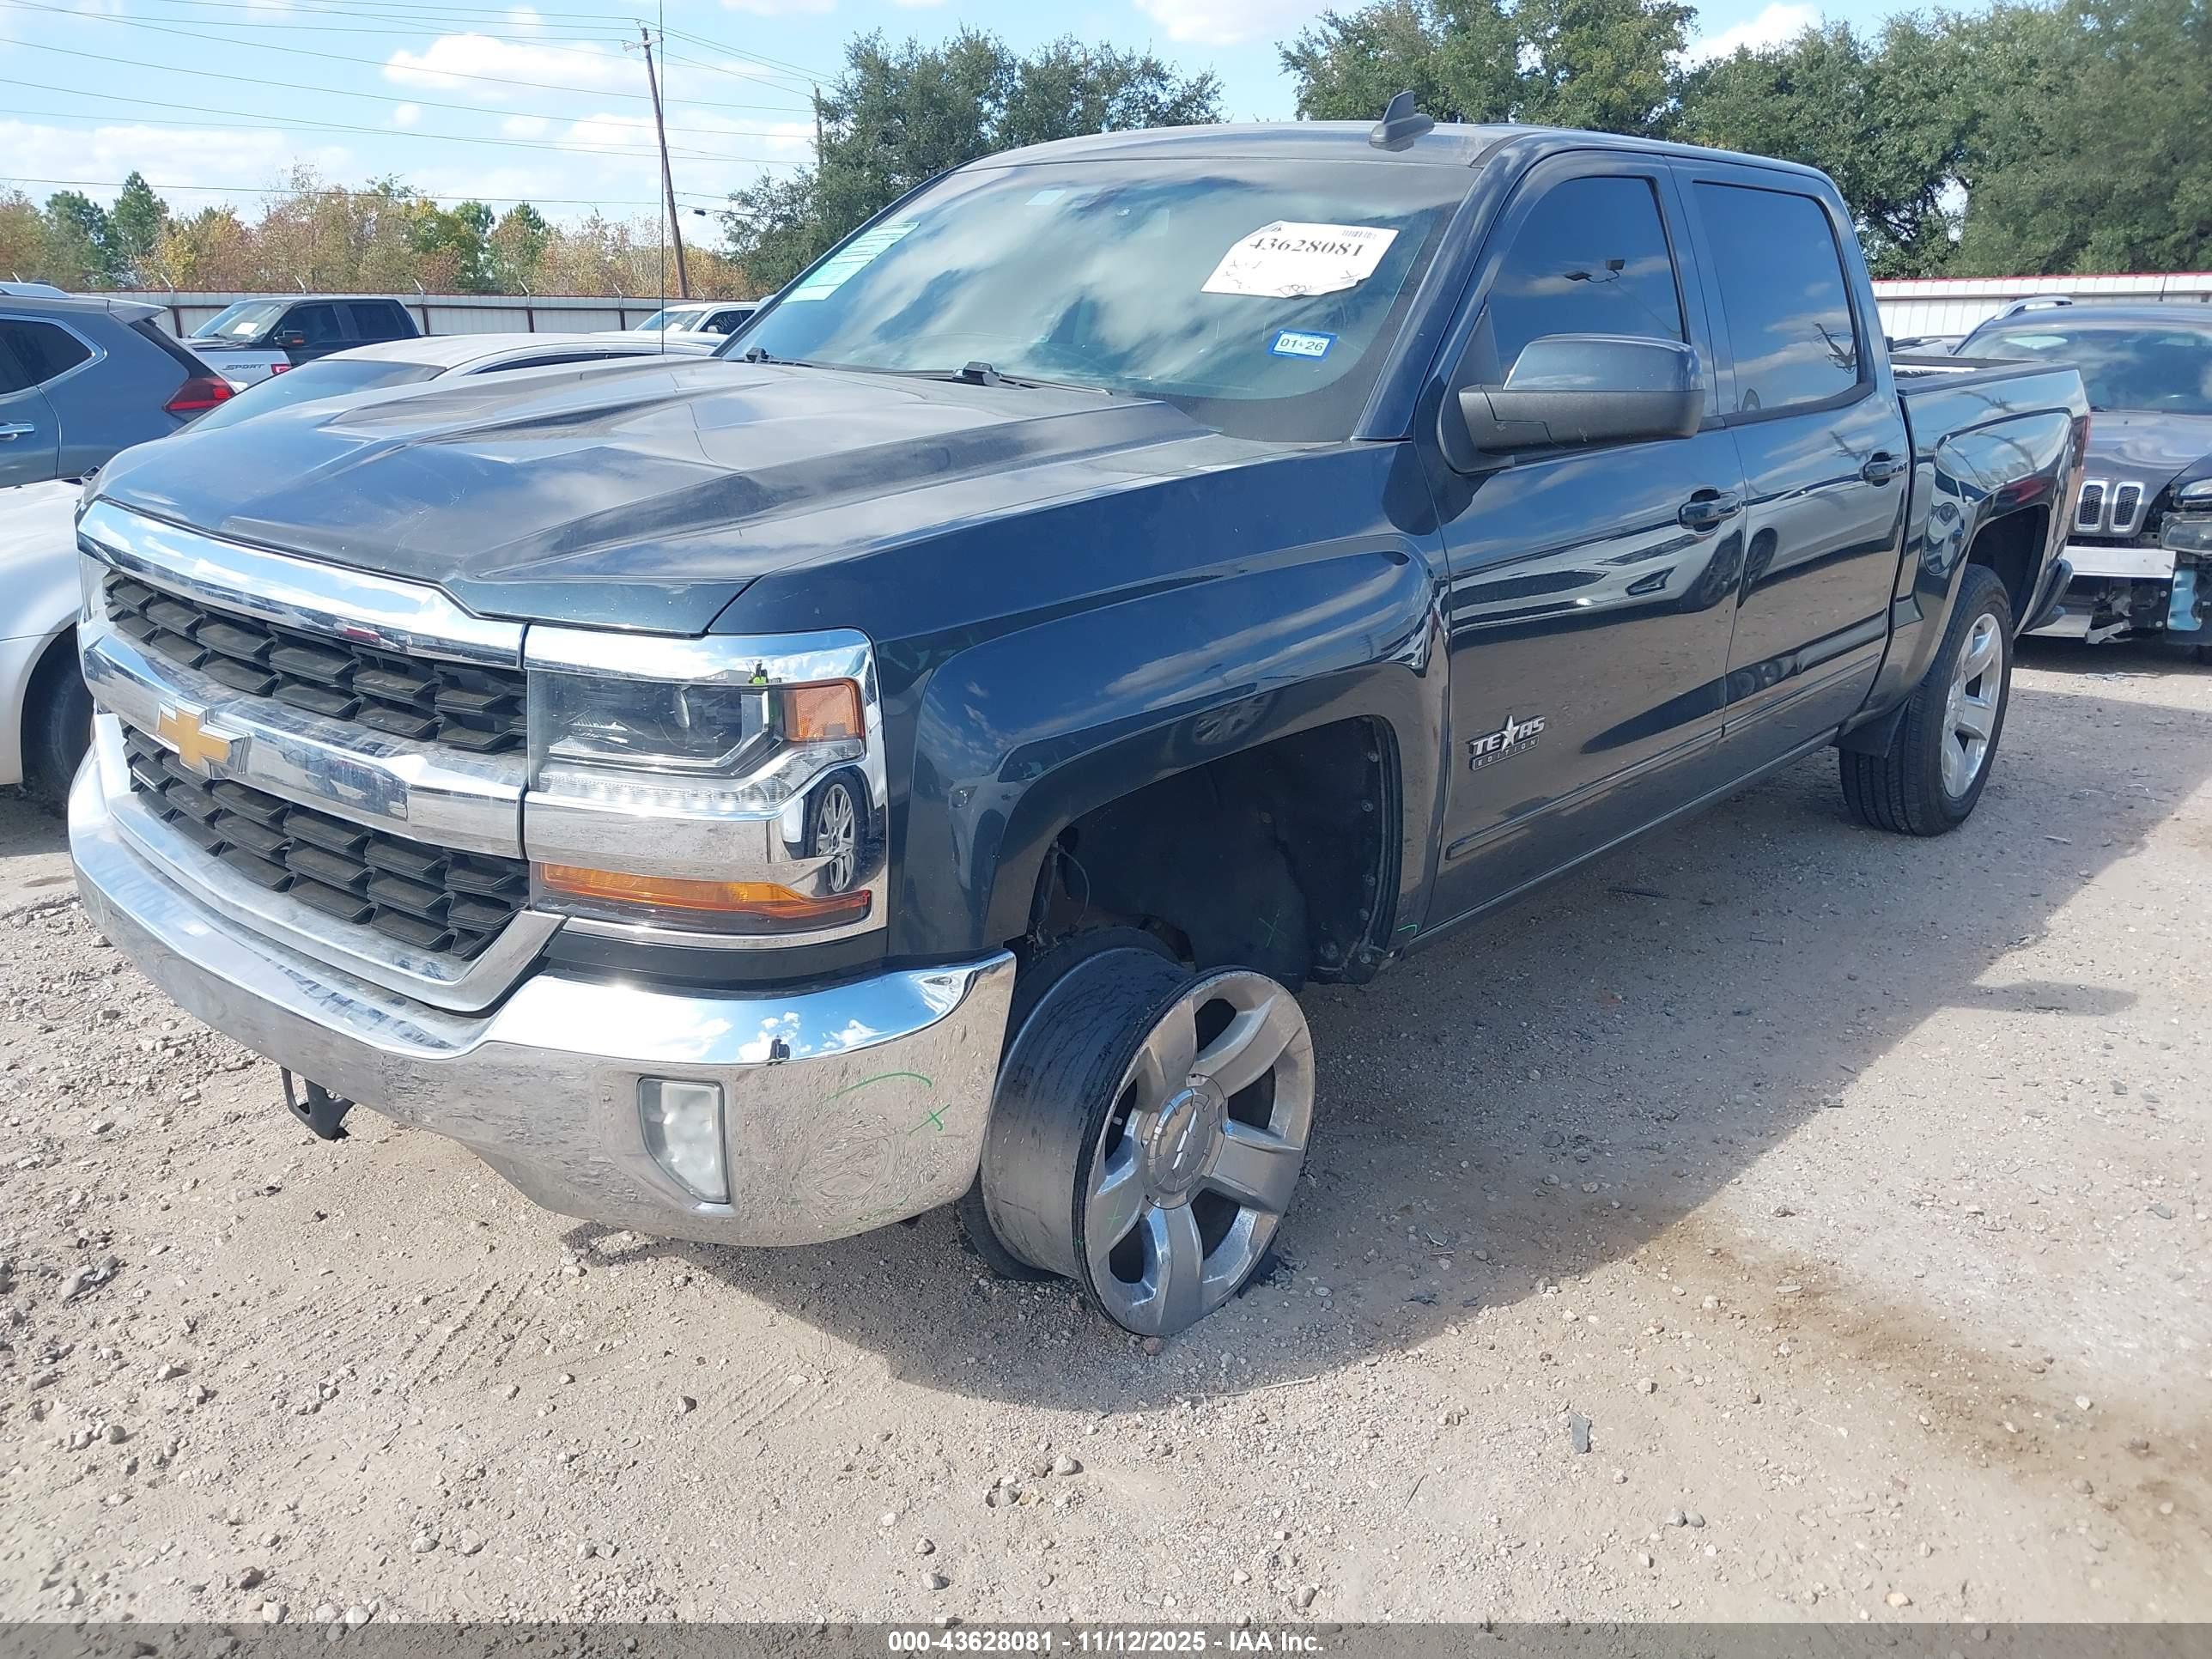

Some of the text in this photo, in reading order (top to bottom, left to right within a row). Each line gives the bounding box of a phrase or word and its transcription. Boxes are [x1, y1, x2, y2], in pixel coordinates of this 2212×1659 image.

[1249, 237, 1364, 257] 43628081
[1470, 714, 1547, 756] TEXAS
[1478, 739, 1536, 767] EDITION
